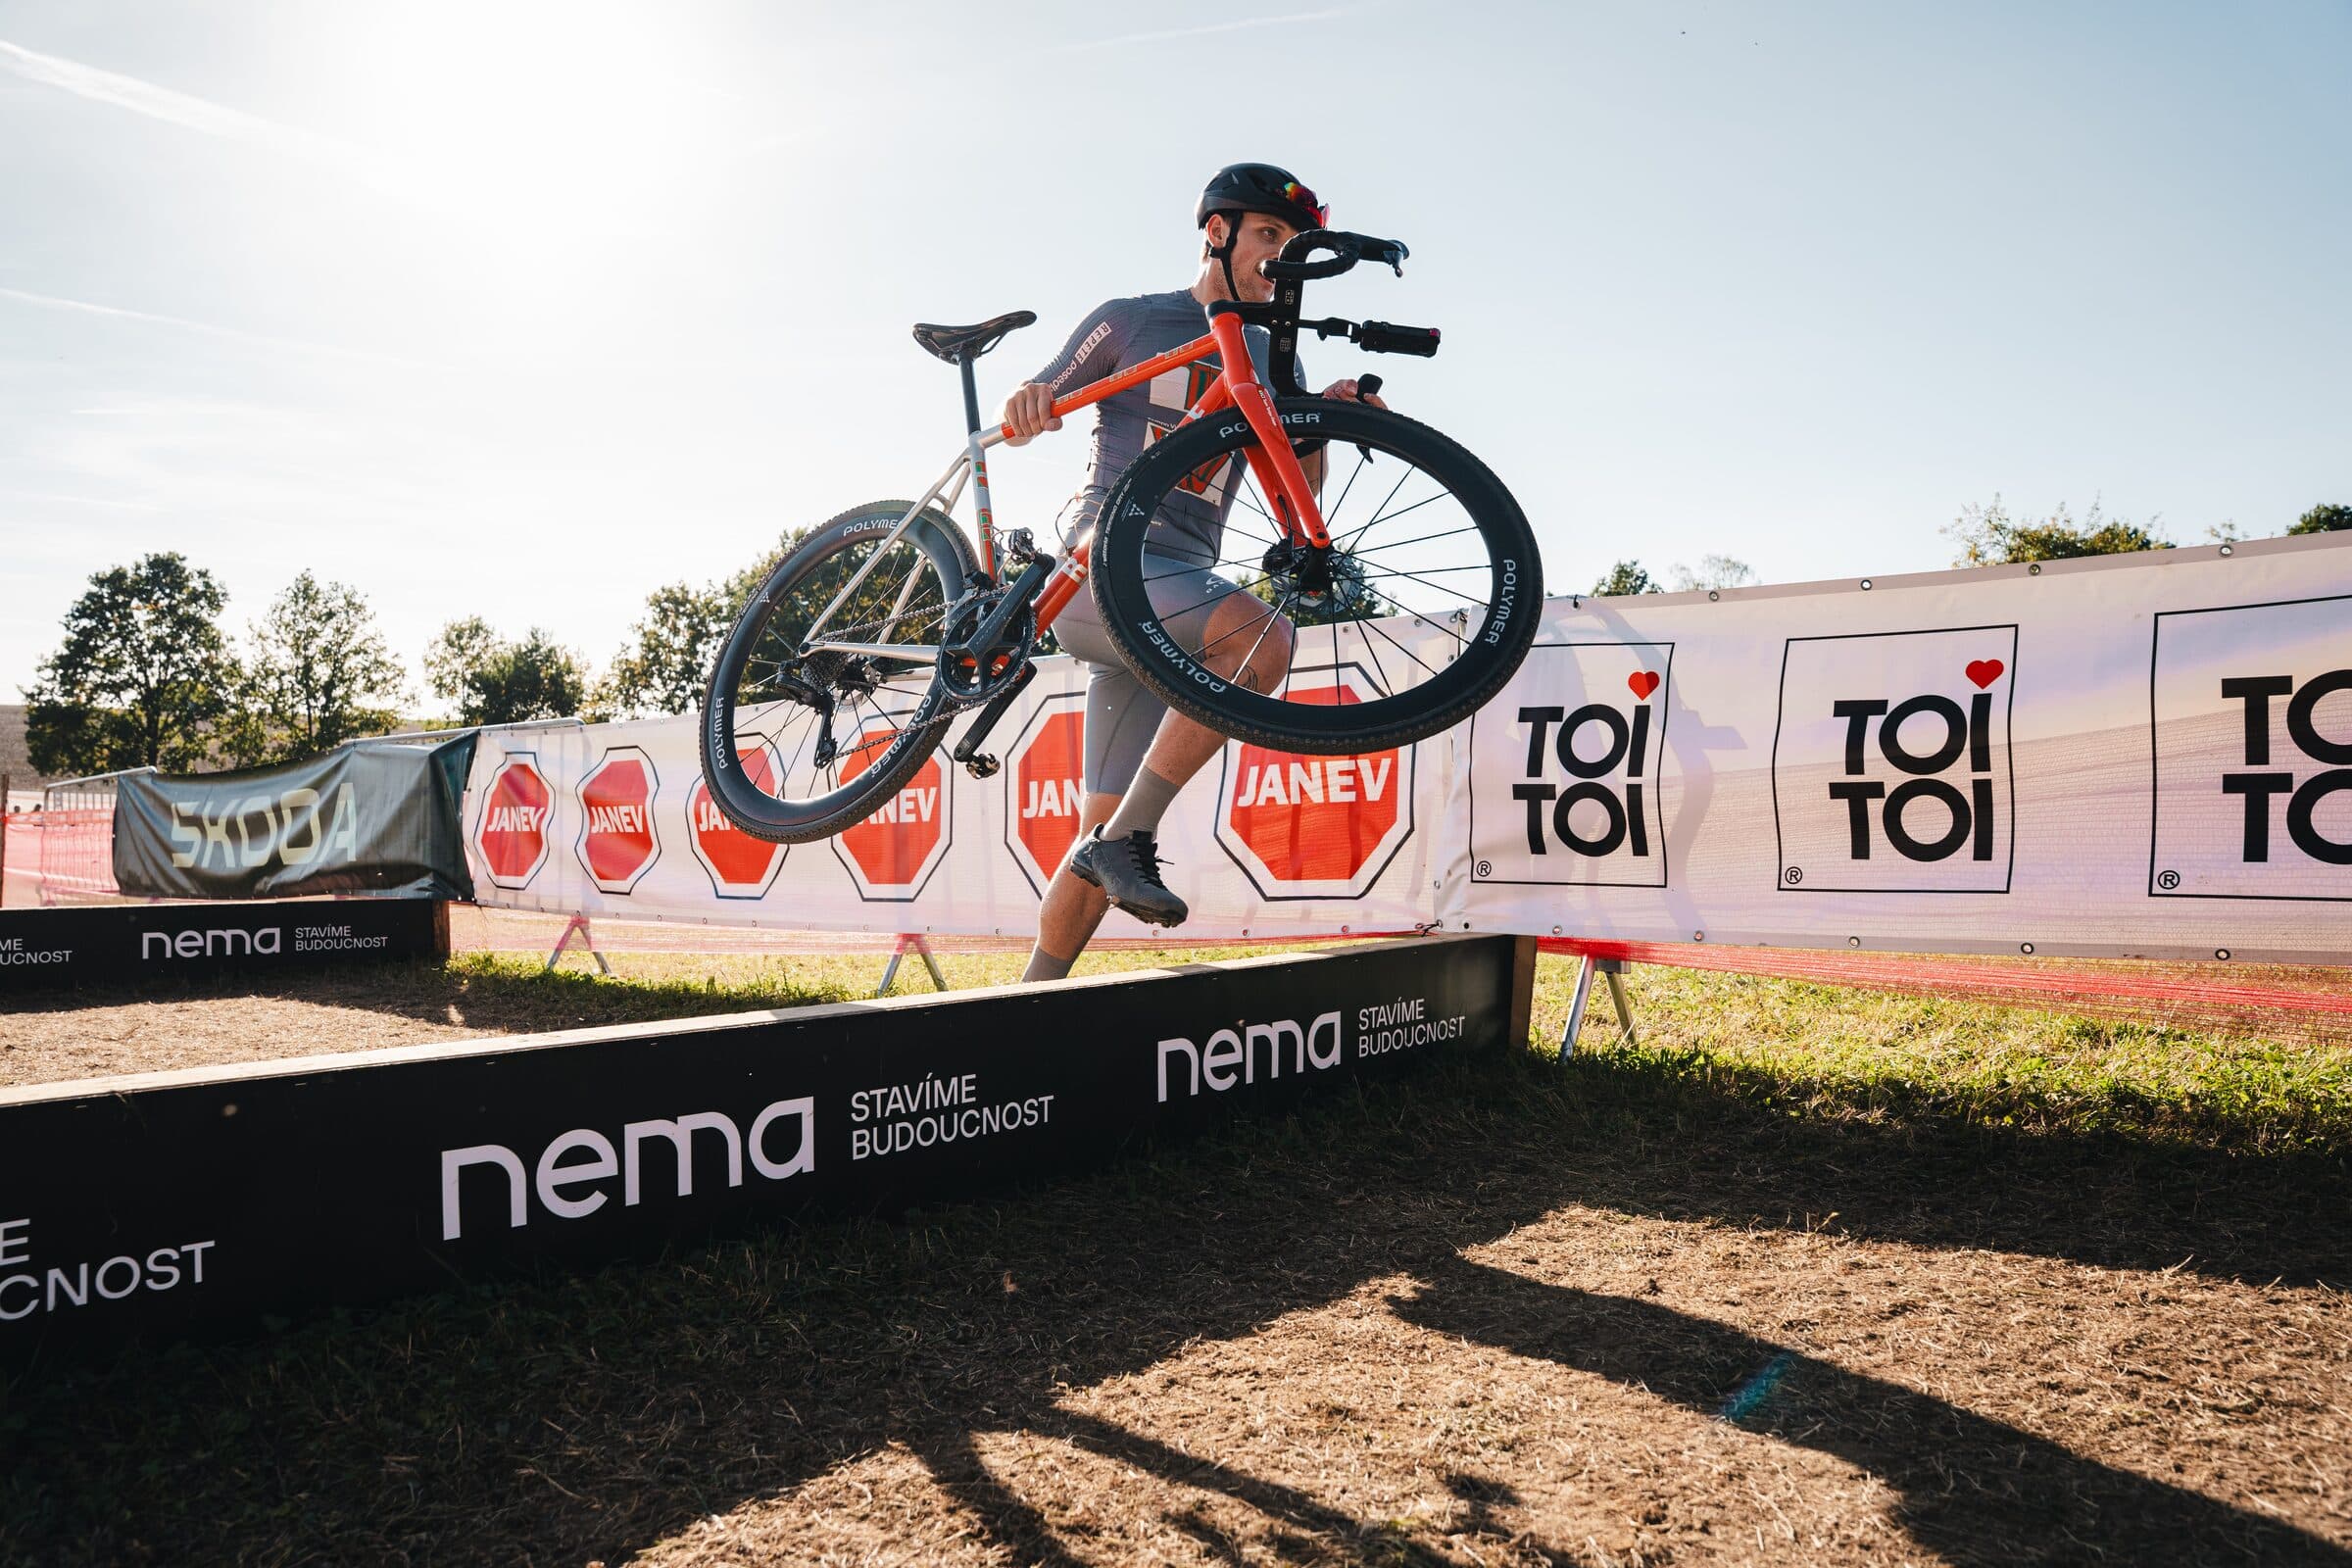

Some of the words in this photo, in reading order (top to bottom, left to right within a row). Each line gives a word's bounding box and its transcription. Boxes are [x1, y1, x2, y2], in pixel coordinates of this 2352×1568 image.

[1077, 321, 1111, 364] REPETE
[1485, 559, 1516, 644] POLYMER
[1141, 620, 1226, 693] POLYMER
[714, 697, 728, 769] POLYMER
[1022, 777, 1084, 818] JAN
[1237, 758, 1392, 807] JANEV
[487, 806, 545, 832] JANEV
[591, 805, 644, 833] JANEV
[1512, 781, 1648, 857] TOI
[1829, 778, 1993, 861] TOI
[142, 927, 280, 959] nema
[295, 924, 351, 938] STAVÍME
[295, 936, 388, 952] BUDOUCNOST
[1358, 997, 1425, 1031] STAVÍME
[1358, 1015, 1465, 1058] BUDOUCNOST
[1157, 1010, 1341, 1102] nema
[851, 1072, 977, 1122] STAVÍME
[852, 1095, 1054, 1160] BUDOUCNOST
[441, 1096, 814, 1241] nema
